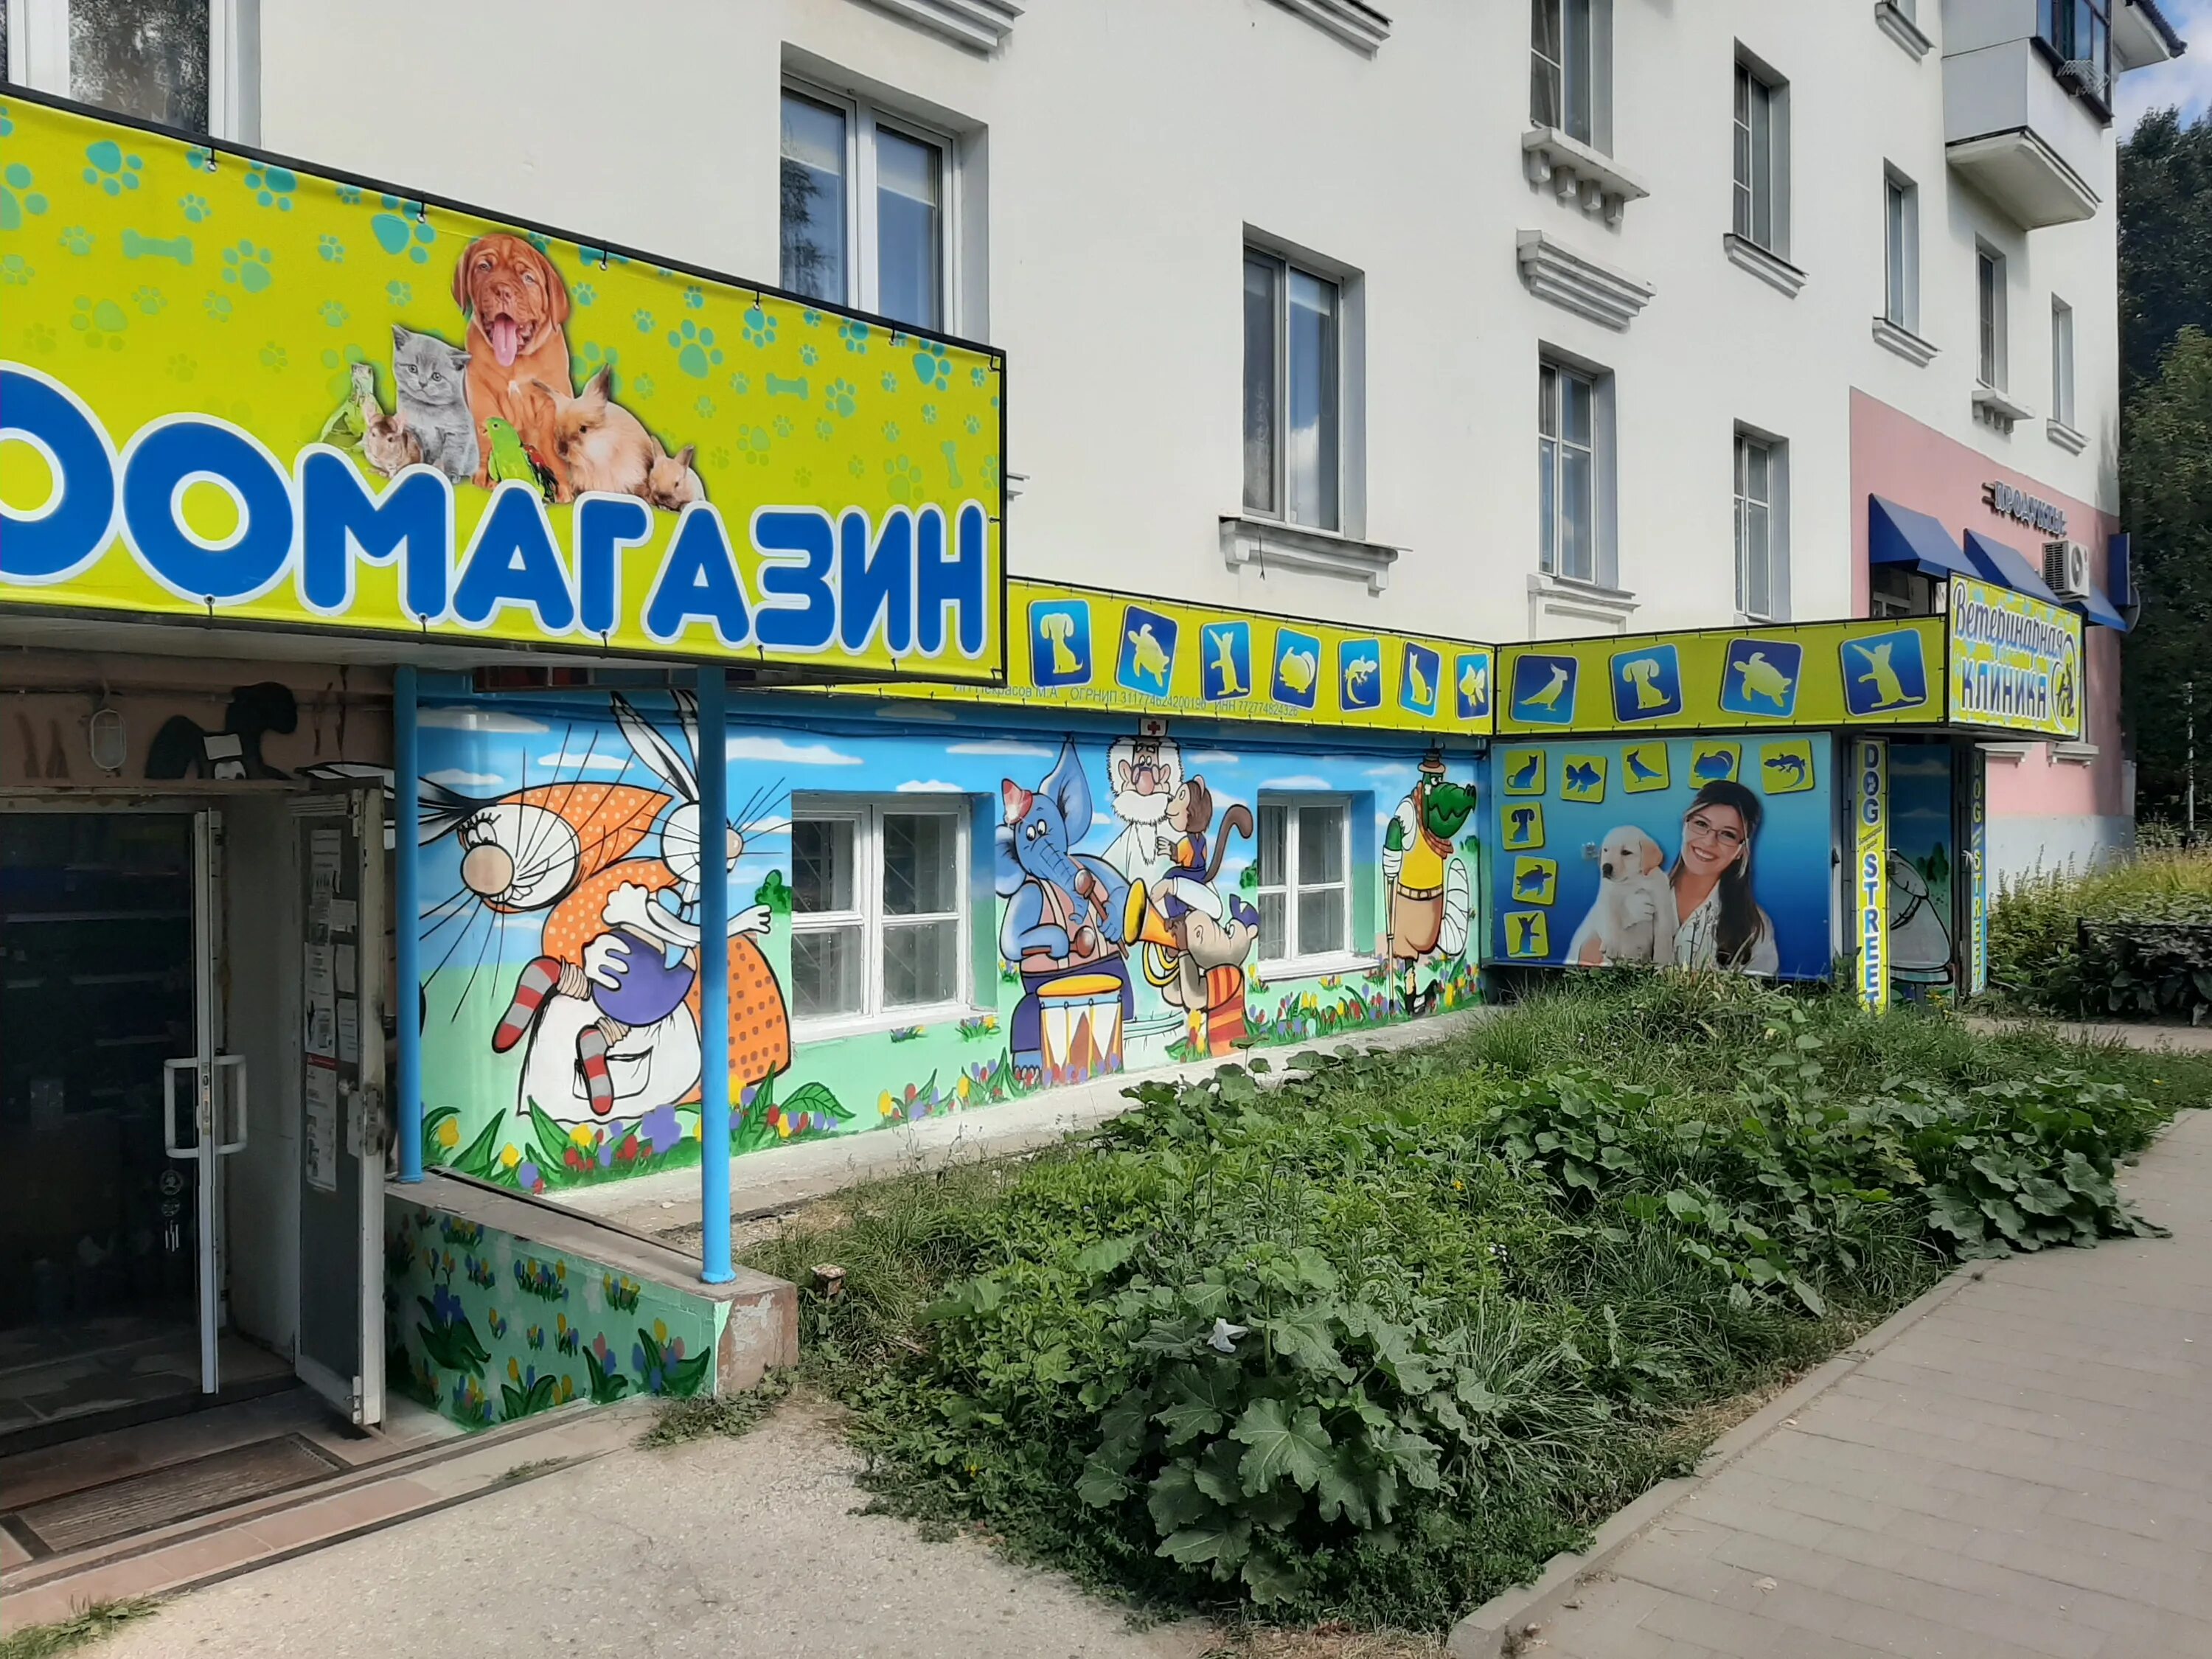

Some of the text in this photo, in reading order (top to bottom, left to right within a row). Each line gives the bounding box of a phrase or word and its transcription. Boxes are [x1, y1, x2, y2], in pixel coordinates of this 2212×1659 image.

[1994, 481, 2064, 537] ПРОДУКТЫ
[1954, 581, 2064, 667] Ветеринарная
[1070, 686, 1117, 703] ОГРНИП
[1214, 699, 1236, 712] ИНН
[1863, 743, 1880, 824] DOG
